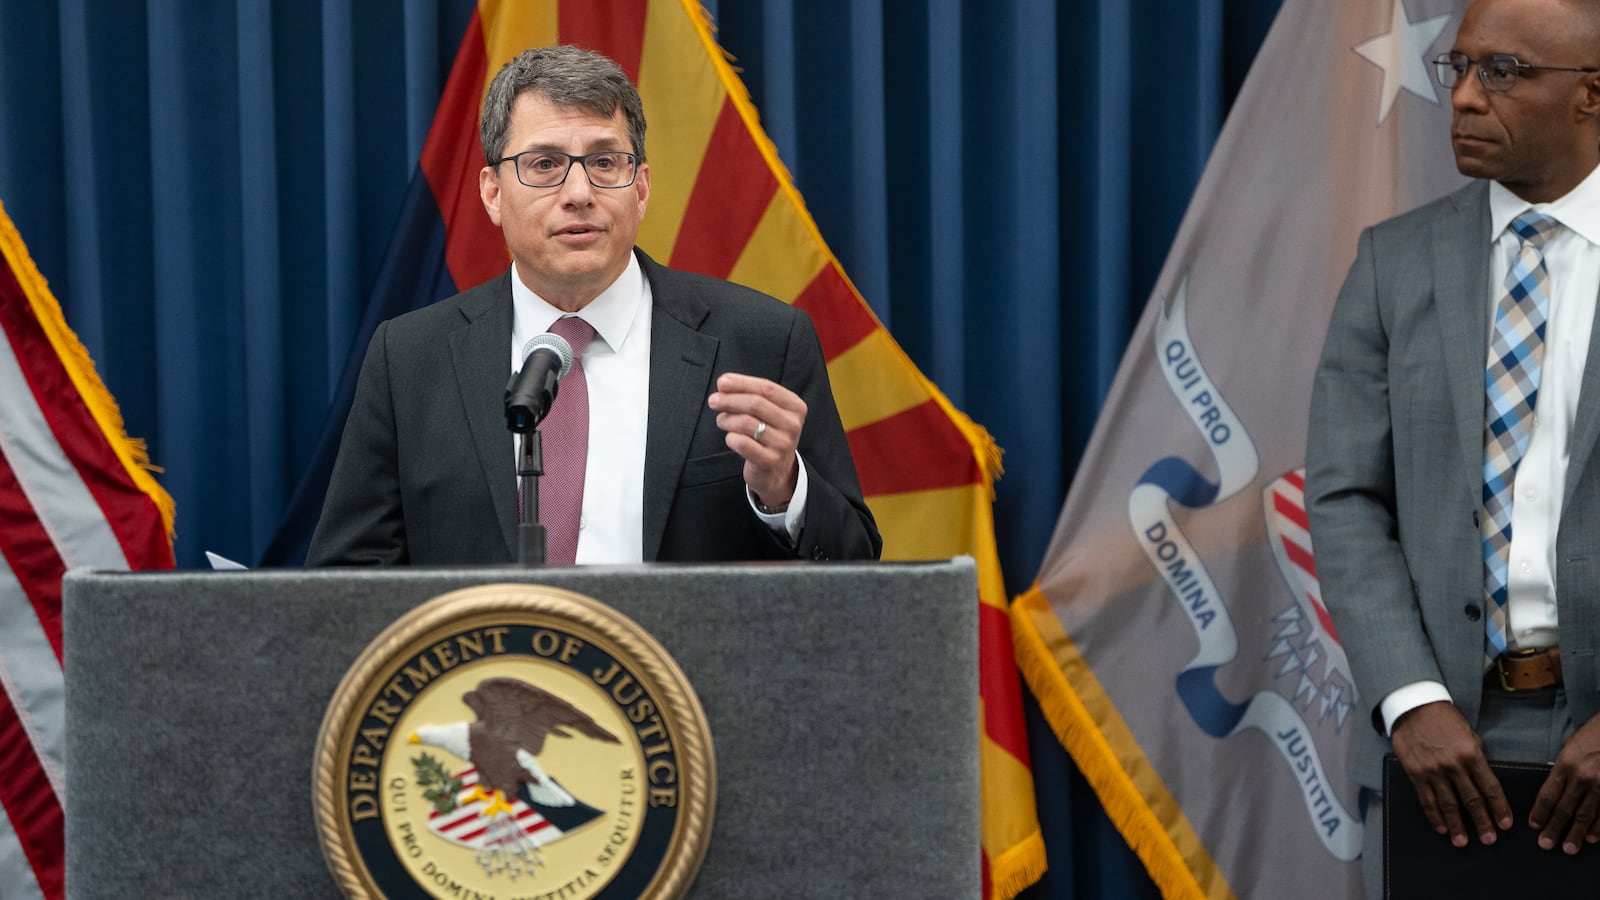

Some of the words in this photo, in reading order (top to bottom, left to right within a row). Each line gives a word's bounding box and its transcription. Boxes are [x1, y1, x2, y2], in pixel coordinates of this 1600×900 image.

[1166, 340, 1201, 390] QUI
[1192, 389, 1231, 445] PRO
[1145, 521, 1216, 630] DOMINA
[350, 627, 510, 822] DEPARTMENT
[531, 630, 584, 664] OF
[593, 660, 678, 809] JUSTICE
[389, 777, 407, 812] QUI
[398, 821, 422, 858] PRO
[423, 861, 495, 900] DOMIN
[511, 868, 599, 900] TITIA
[597, 768, 635, 867] SEQUITUR
[1277, 727, 1341, 837] JUSTITIA
